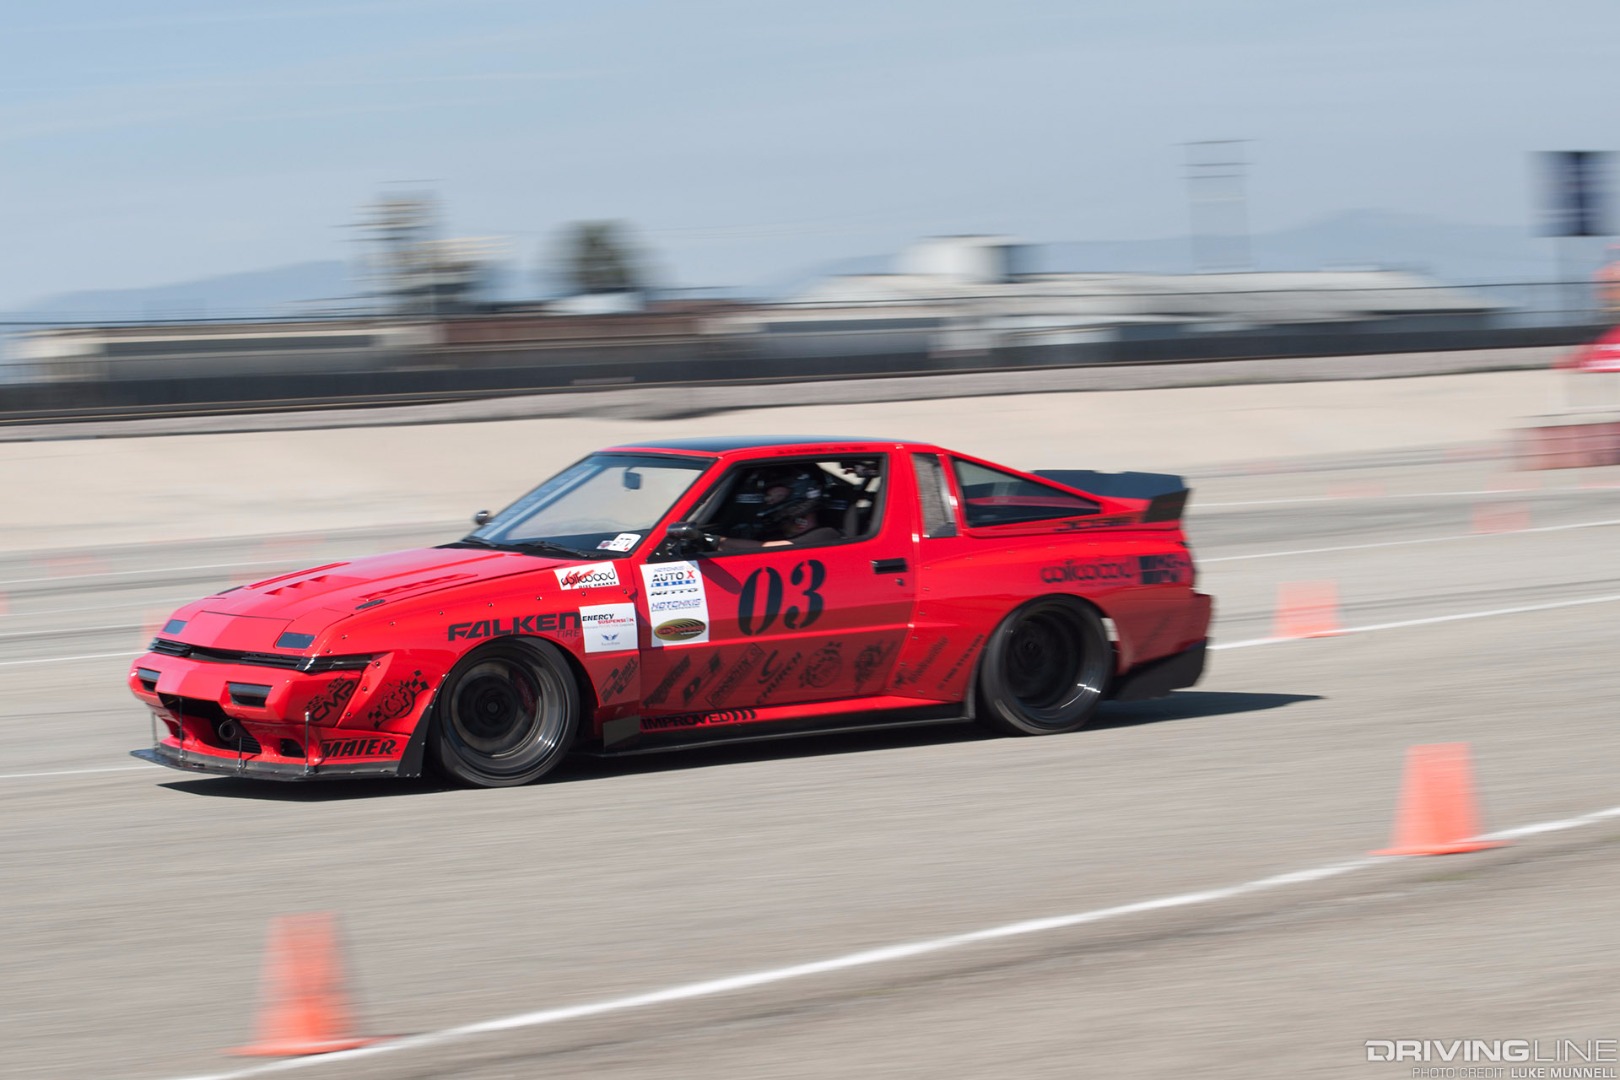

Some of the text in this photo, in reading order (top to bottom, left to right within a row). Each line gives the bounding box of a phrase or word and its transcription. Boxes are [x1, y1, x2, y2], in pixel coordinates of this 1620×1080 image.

[652, 570, 695, 582] AUTO X
[738, 560, 827, 636] 03
[447, 611, 581, 641] FALKEN
[582, 613, 615, 622] ENERGY
[320, 738, 398, 759] MAIER
